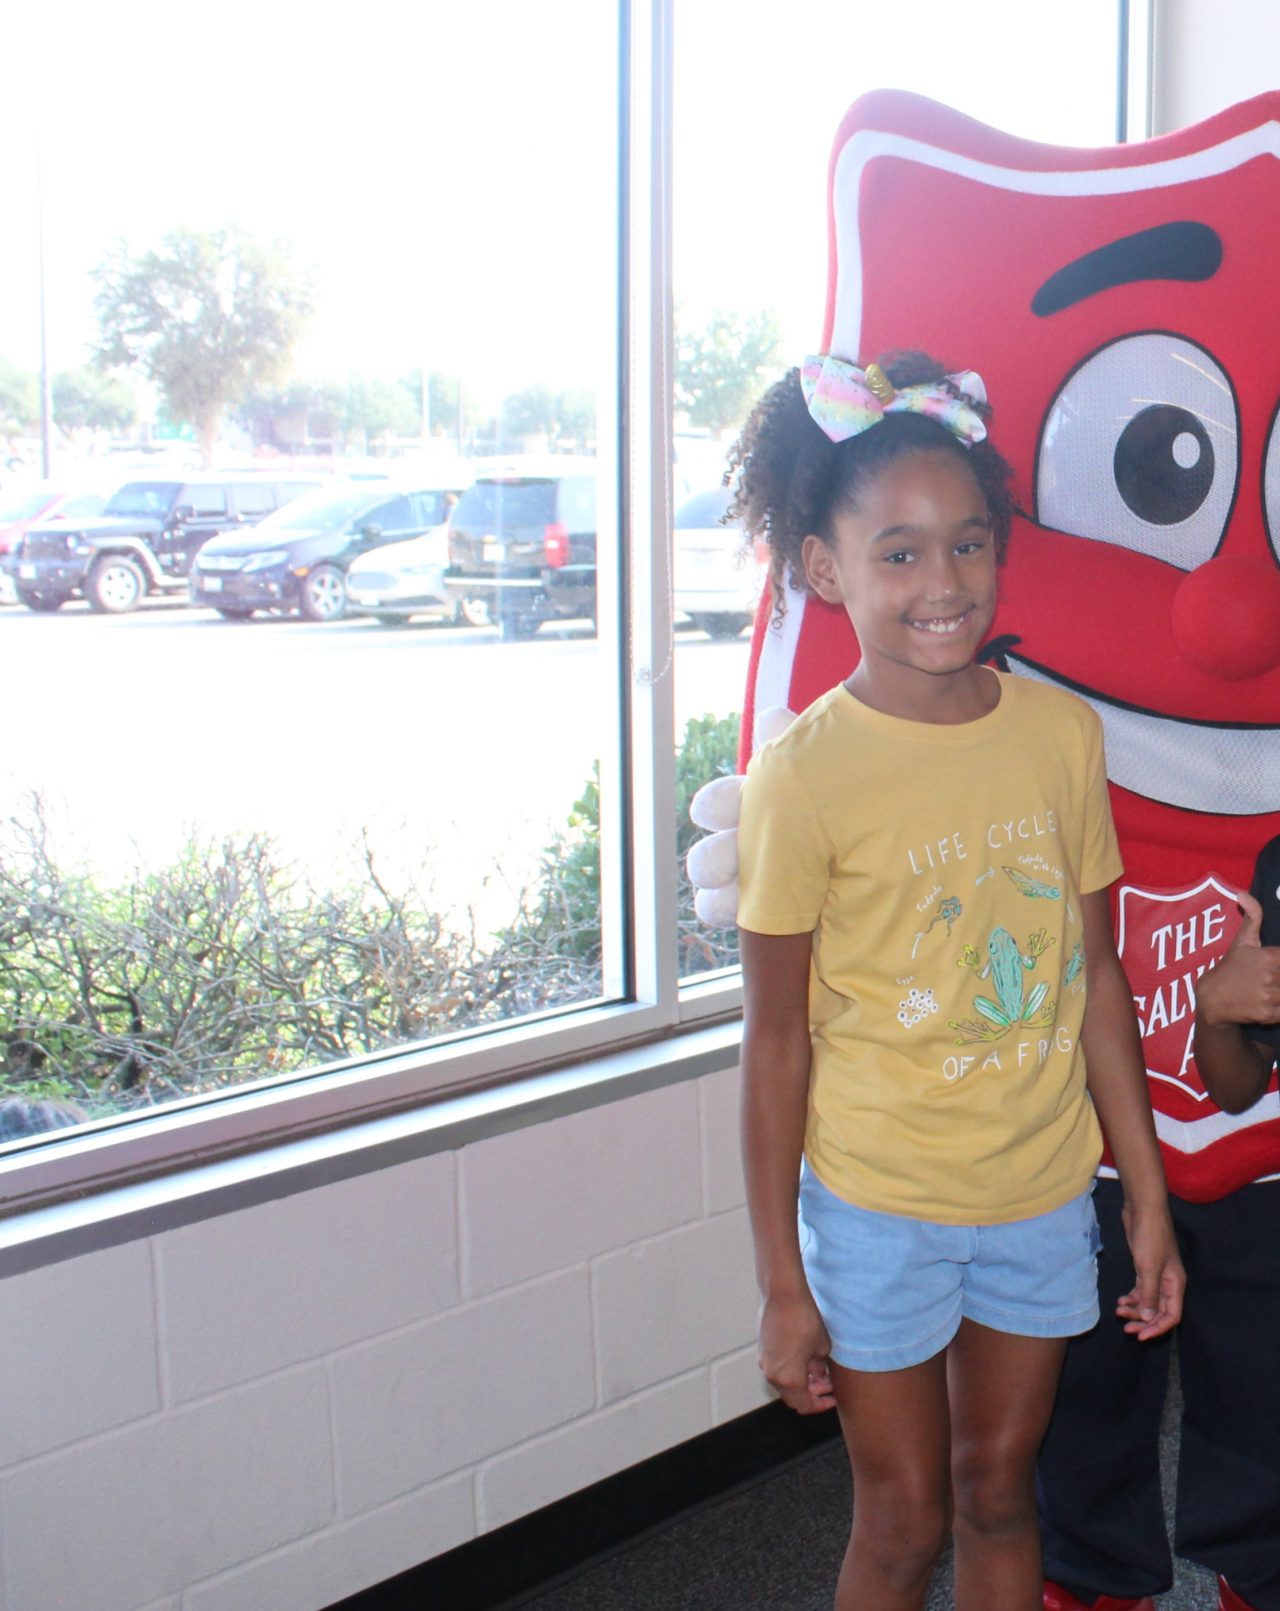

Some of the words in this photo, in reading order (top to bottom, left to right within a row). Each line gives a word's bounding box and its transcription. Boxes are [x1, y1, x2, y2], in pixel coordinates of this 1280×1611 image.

[908, 832, 968, 875] LIFE
[987, 811, 1057, 848] CYCLE
[1150, 903, 1226, 971] THE
[942, 1055, 976, 1080] OF
[982, 1050, 1002, 1071] A
[1017, 1027, 1072, 1068] FRG
